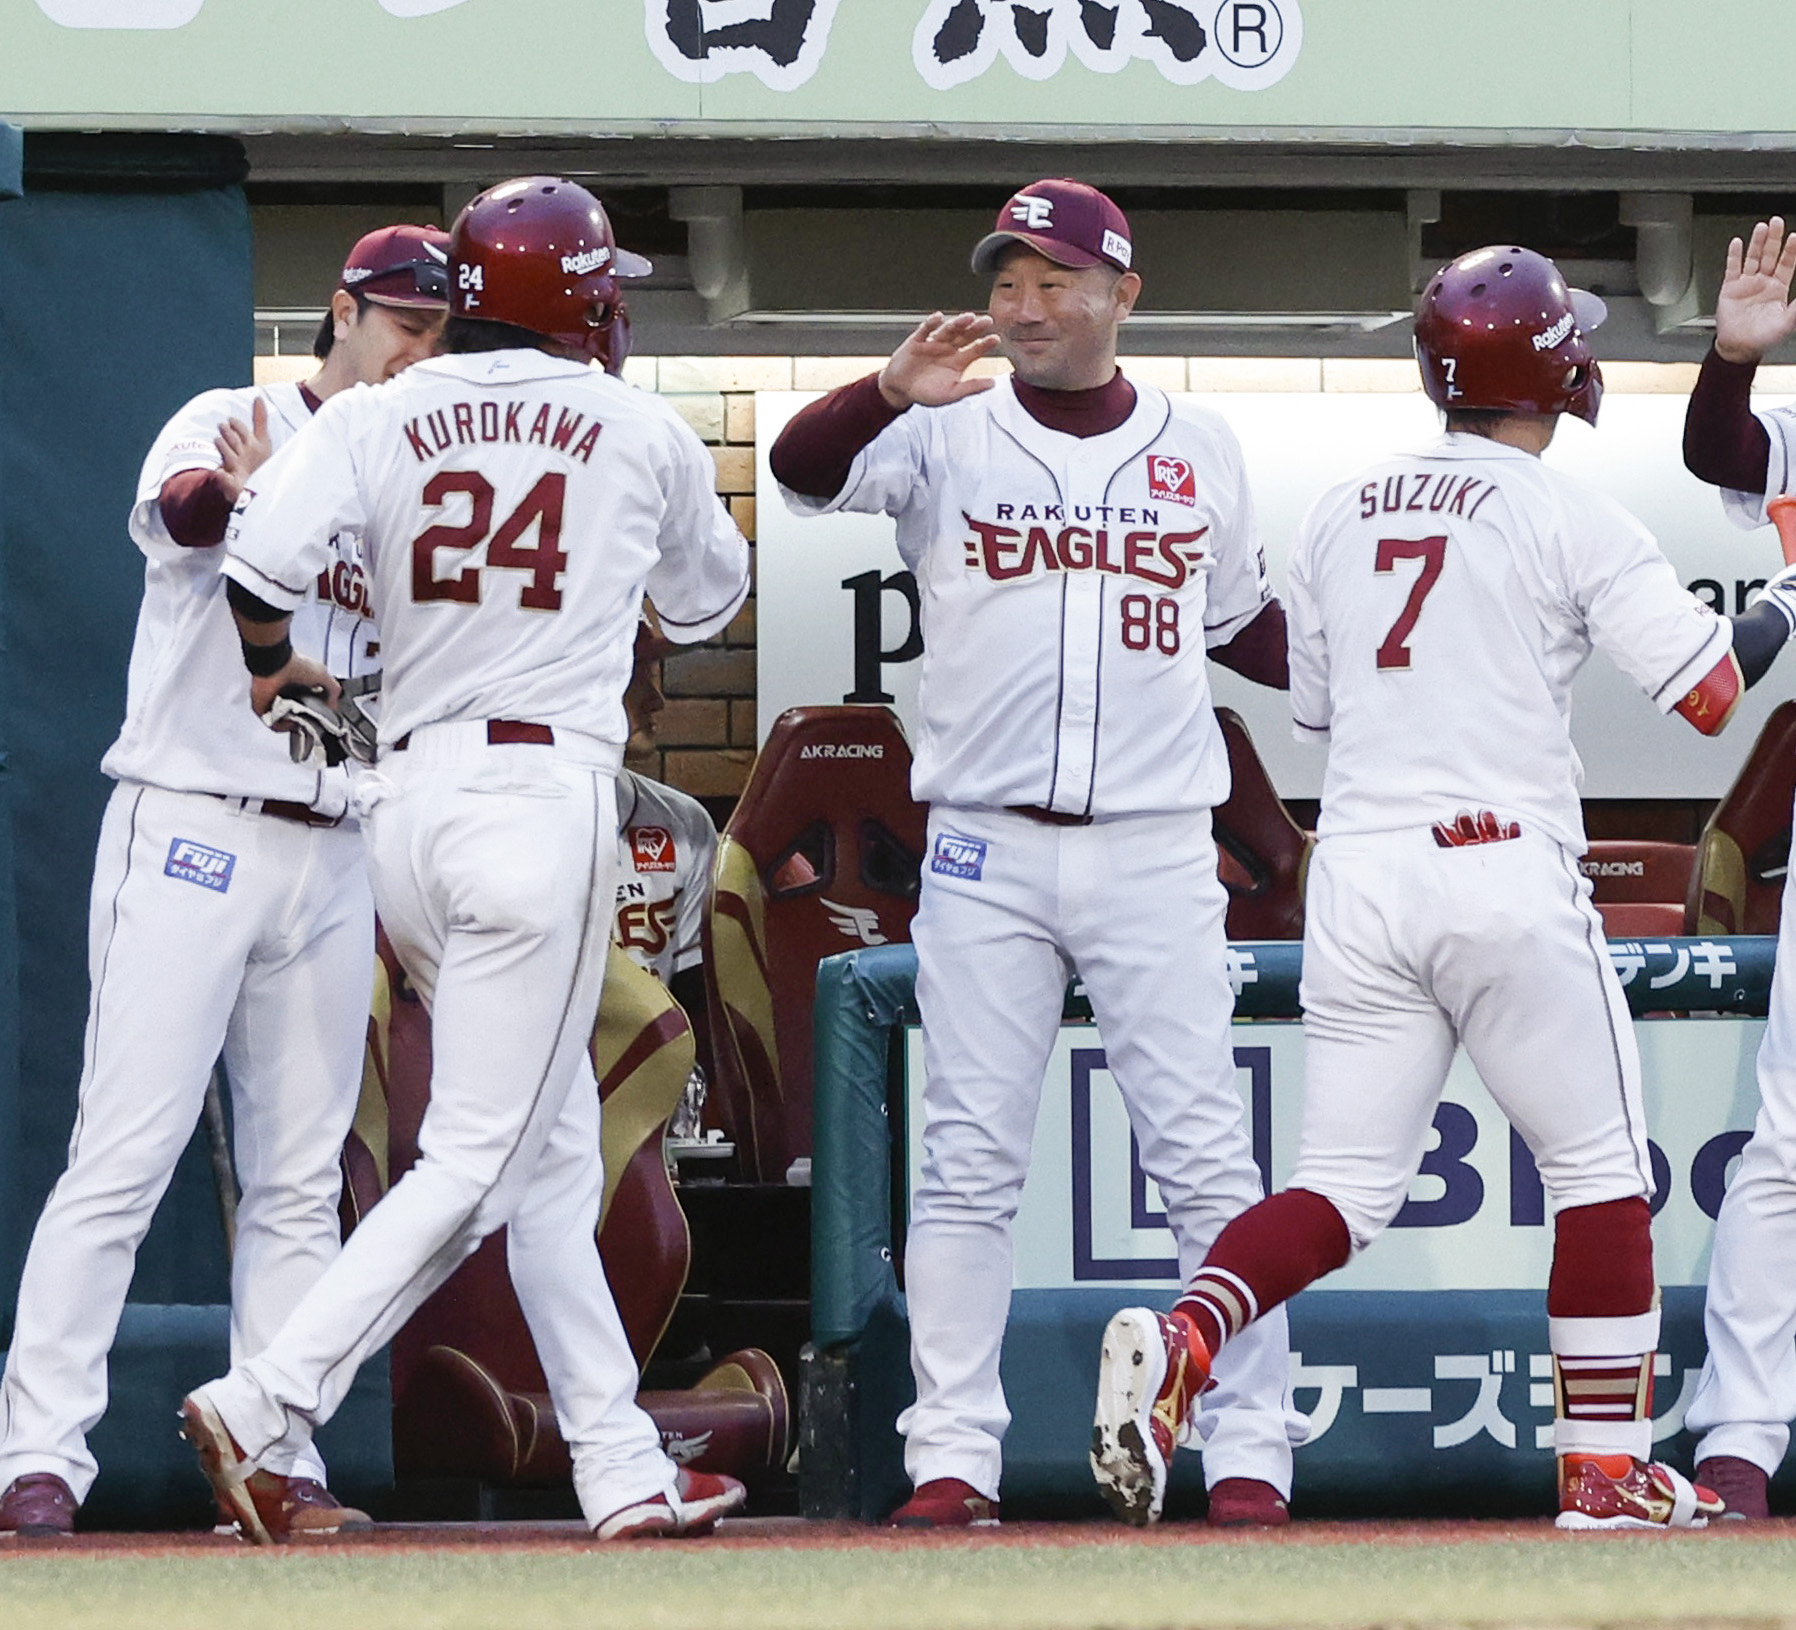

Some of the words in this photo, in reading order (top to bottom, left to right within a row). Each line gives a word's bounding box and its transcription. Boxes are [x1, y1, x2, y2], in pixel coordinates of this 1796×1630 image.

[458, 263, 484, 291] 24
[562, 246, 611, 275] Rakuten
[1532, 311, 1576, 352] Rakuten
[1441, 357, 1457, 382] 7
[403, 401, 604, 464] KUROKAWA
[996, 502, 1160, 526] RAKUTEN
[1360, 472, 1498, 521] SUZUKI
[409, 469, 570, 612] 24
[964, 511, 1209, 590] EAGLES
[1373, 535, 1448, 671] 7
[1120, 594, 1180, 657] 88
[800, 744, 884, 760] AKRACING
[173, 841, 232, 874] Fuji
[939, 836, 982, 865] Fuji
[1607, 941, 1737, 990] デンキ
